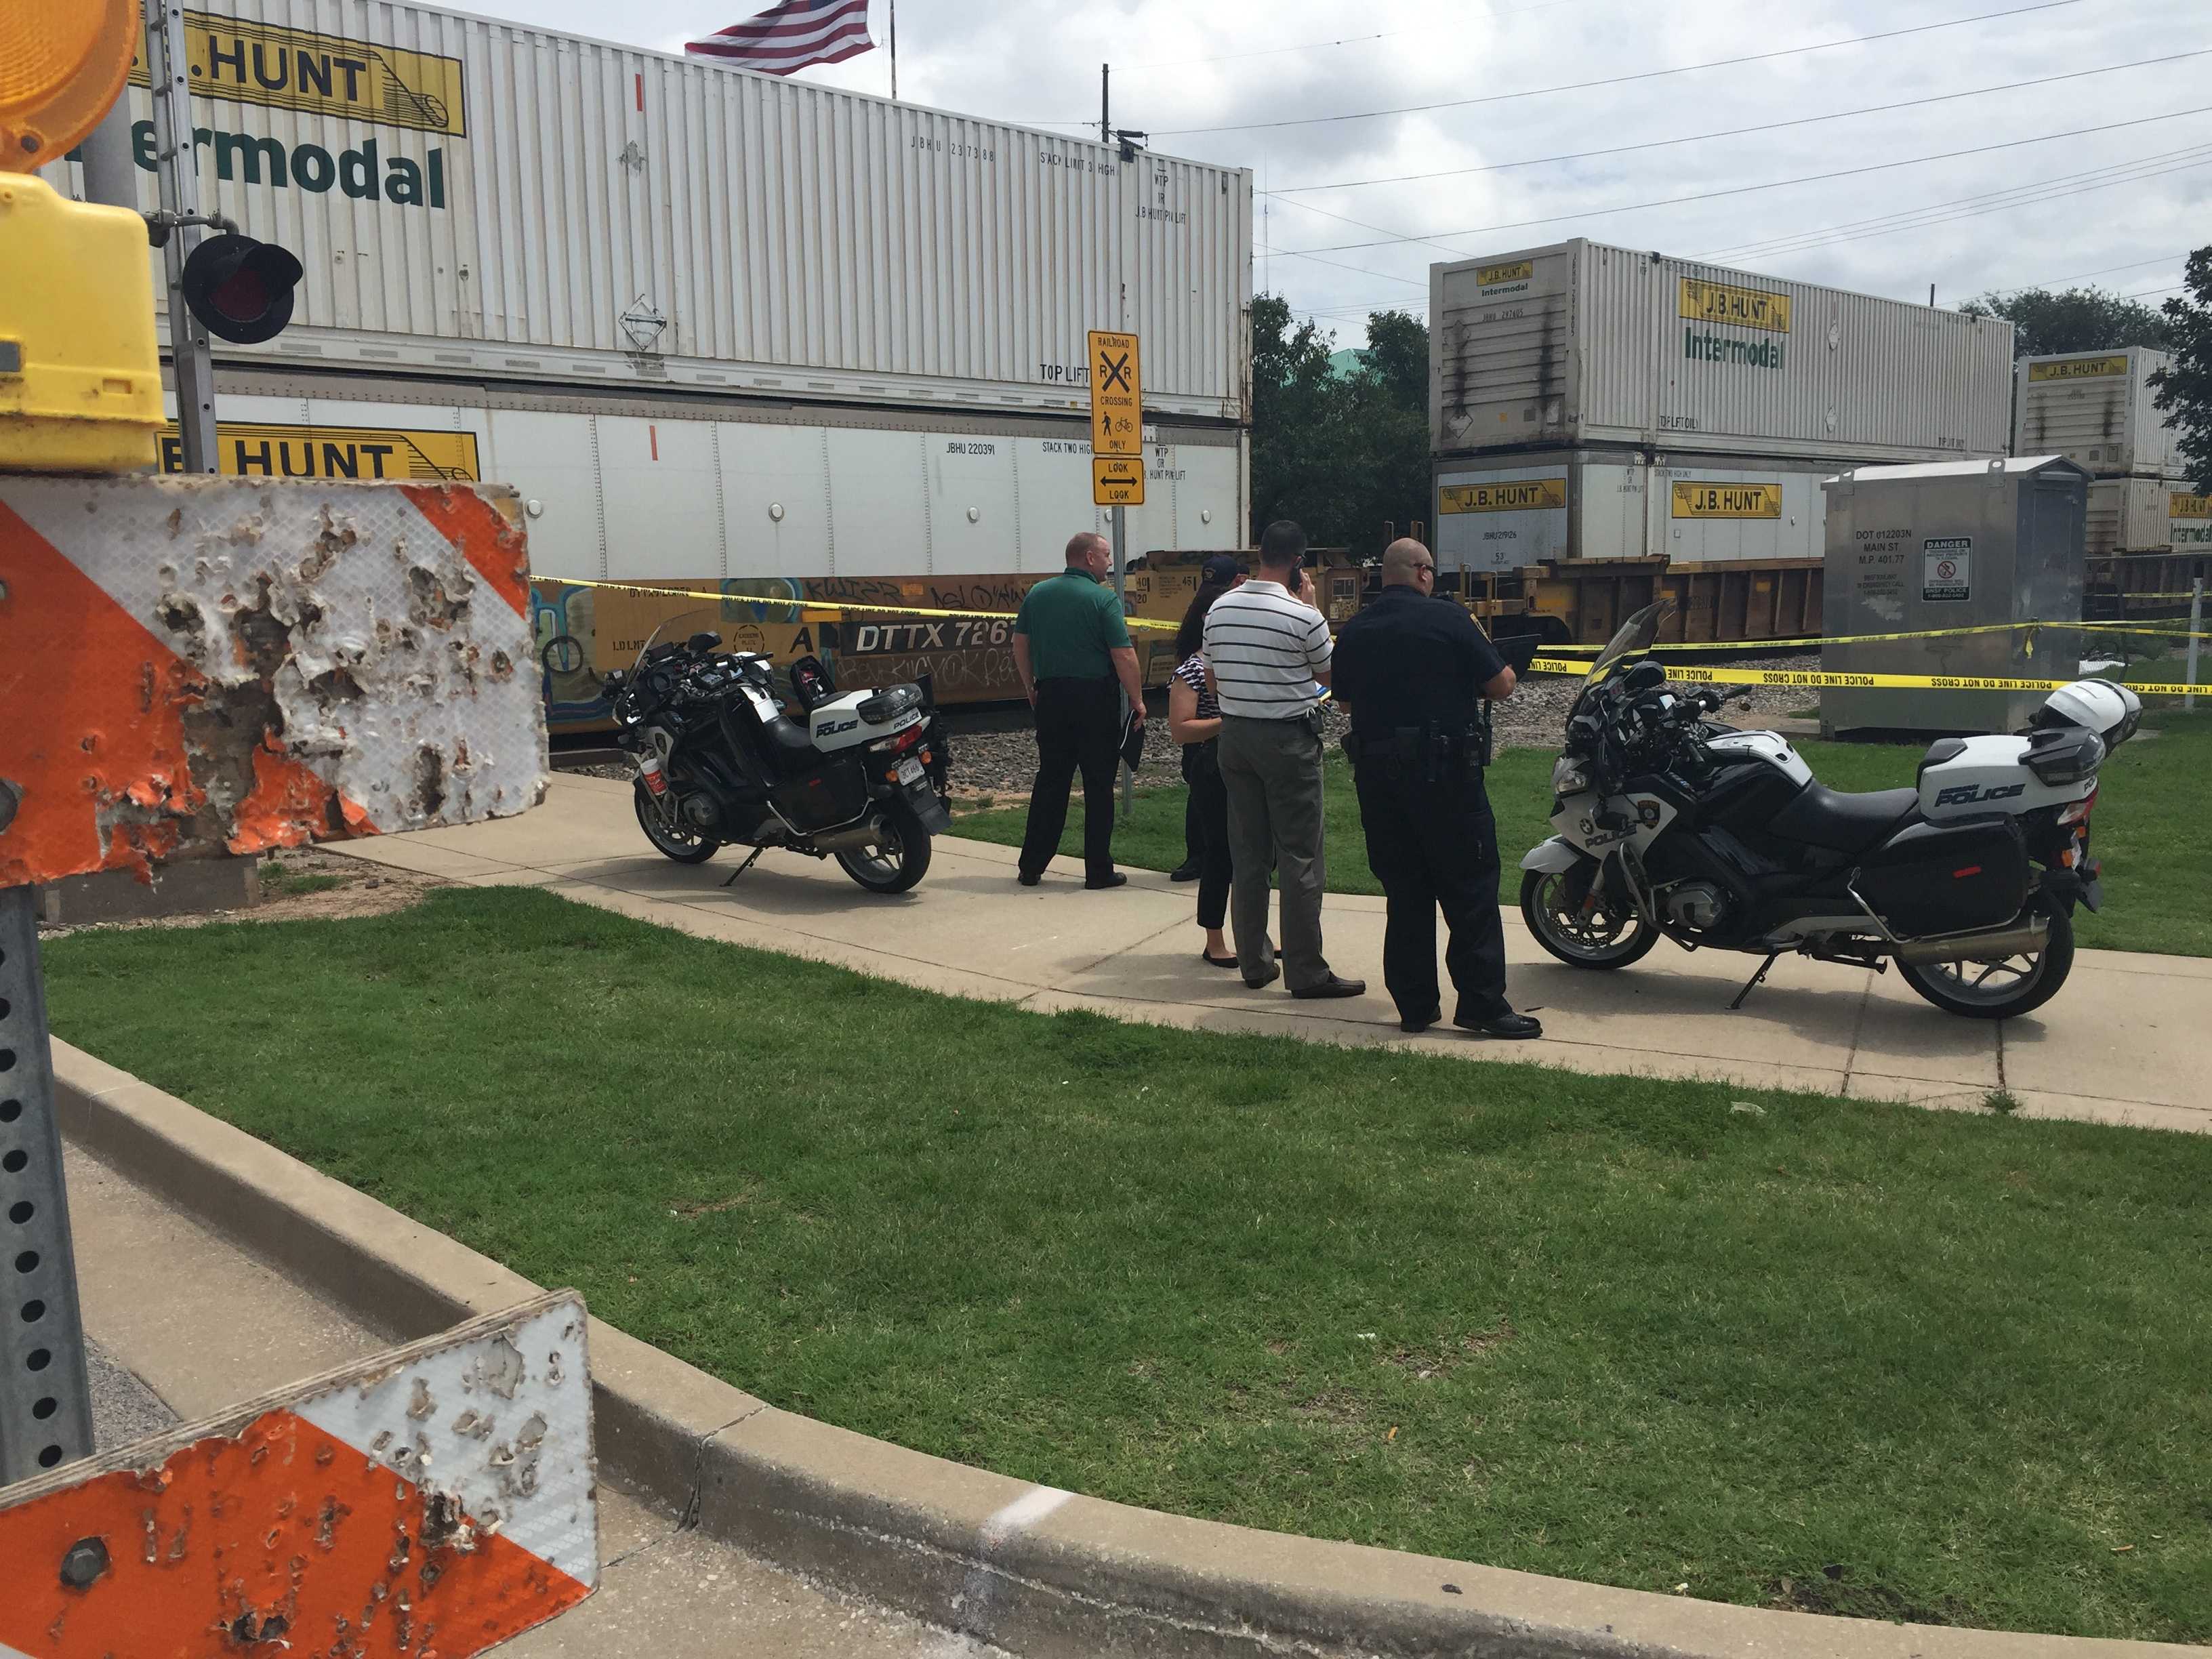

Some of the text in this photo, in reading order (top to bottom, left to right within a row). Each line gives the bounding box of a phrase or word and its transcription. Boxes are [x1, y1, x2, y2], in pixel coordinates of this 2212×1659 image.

[209, 35, 367, 102] HUNT
[911, 136, 994, 162] JBHU 237388
[64, 119, 446, 209] ermodal
[1502, 267, 1521, 279] HUNT
[1481, 283, 1529, 297] Intermodal
[1731, 295, 1767, 321] HUNT
[1098, 337, 1130, 348] RAILROAD
[1685, 327, 1785, 369] Intermodal
[1040, 364, 1090, 384] TOP LIFT
[2073, 362, 2106, 374] HUNT
[1100, 396, 1132, 407] CROSSING
[946, 443, 996, 455] JBHU 220391
[1042, 441, 1063, 453] STACK
[1064, 443, 1077, 454] TWO
[1109, 441, 1126, 450] ONLY
[1155, 447, 1168, 457] WTP
[235, 441, 394, 478] HUNT
[1157, 458, 1165, 468] OR
[1108, 464, 1128, 473] LOOK
[1149, 470, 1164, 480] HUNT
[1109, 491, 1129, 500] LOOK
[1465, 487, 1539, 507] J.B. HUNT
[1694, 490, 1762, 511] J.B. HUNT
[1856, 529, 1912, 540] DOT 012203N
[1864, 542, 1899, 552] MAIN ST
[1927, 540, 1968, 548] DANGER
[1859, 554, 1904, 565] M.P. 401.77
[1137, 594, 1147, 604] 20
[789, 627, 814, 654] A
[856, 623, 945, 651] DTTX
[613, 640, 626, 651] LD
[1529, 660, 1567, 672] POLICE LIN
[1668, 669, 1713, 681] POLICE LINE
[1763, 673, 1874, 686] POLICE LINE DO NOT CROSS
[1931, 678, 2052, 689] POLICE LINE DO NOT CROSS
[893, 712, 920, 730] POLICE
[816, 720, 859, 739] POLICE
[1934, 783, 2026, 807] POLICE
